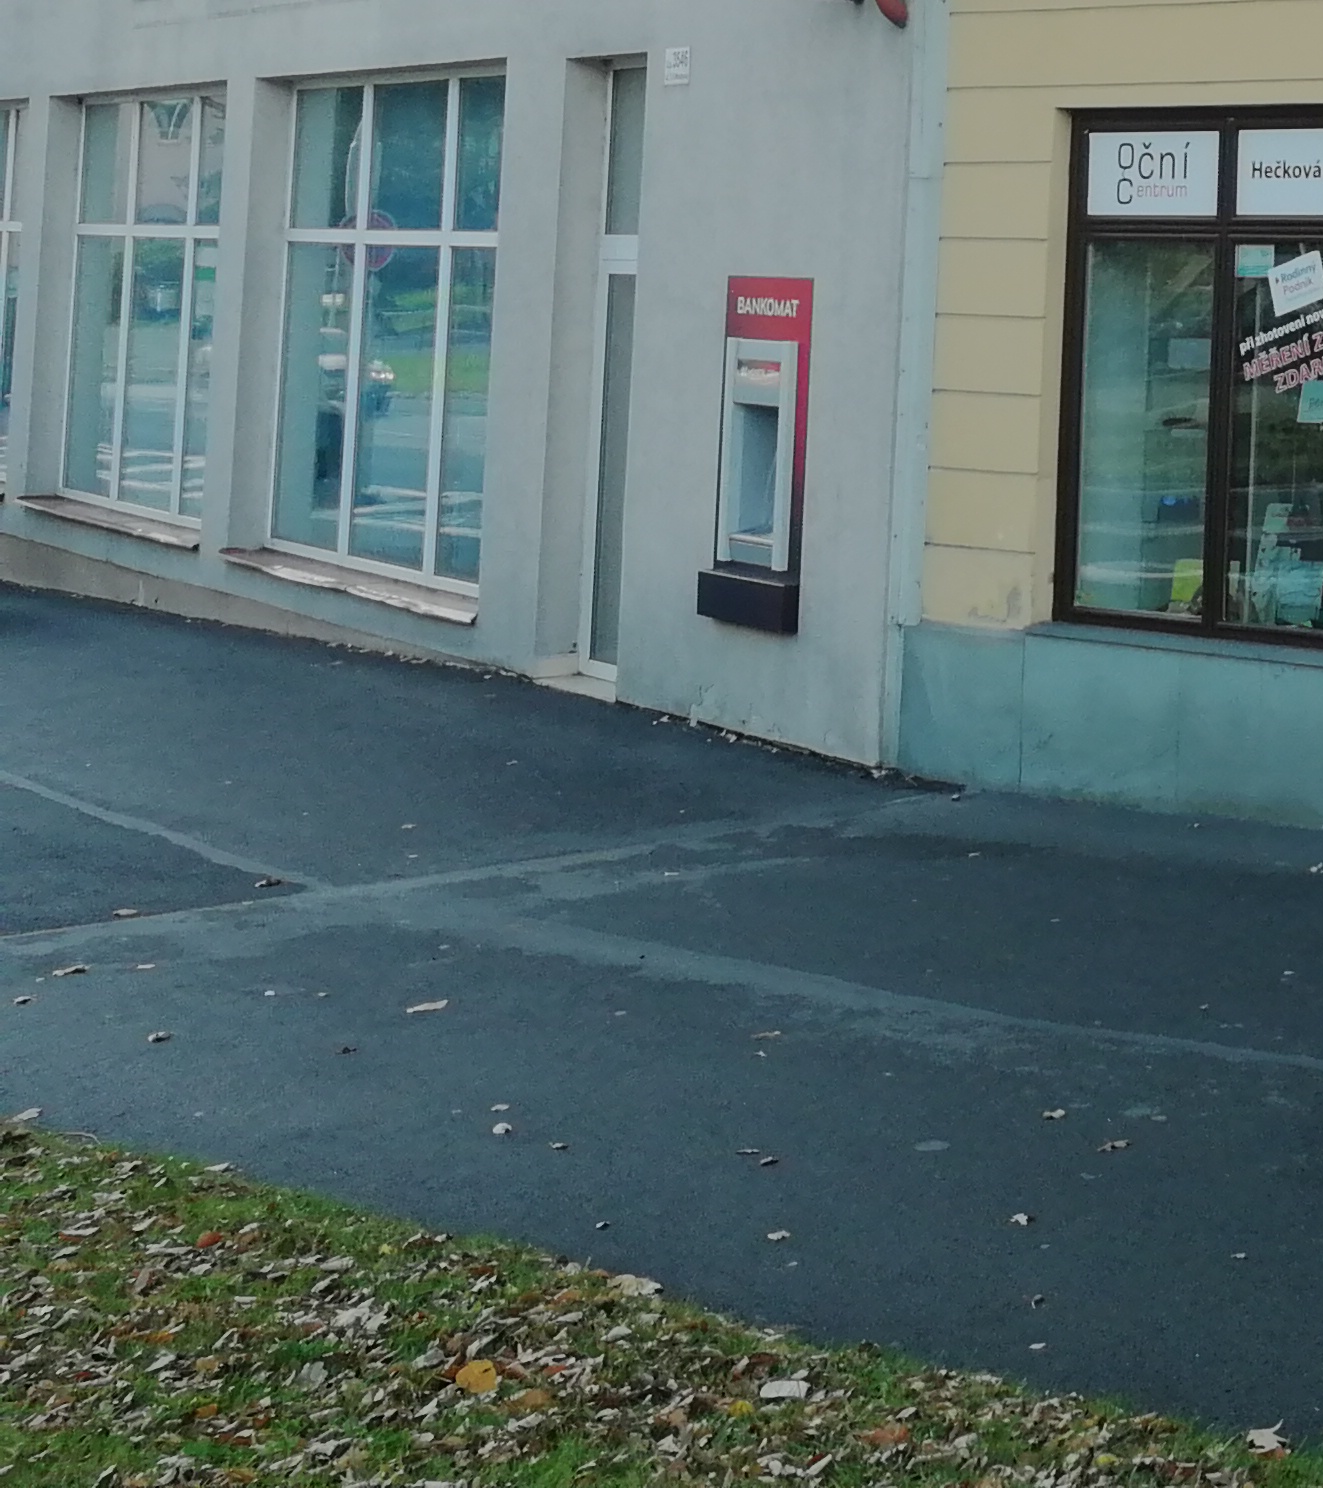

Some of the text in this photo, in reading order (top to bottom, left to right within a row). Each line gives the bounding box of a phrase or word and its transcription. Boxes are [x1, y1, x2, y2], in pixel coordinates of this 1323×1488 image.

[1117, 141, 1190, 180] Oční
[1251, 159, 1321, 179] Hečková
[736, 296, 799, 318] BANKOMAT
[1239, 335, 1255, 356] při
[1255, 316, 1306, 347] zhotovení
[1243, 333, 1310, 381] MĚŘENÍ
